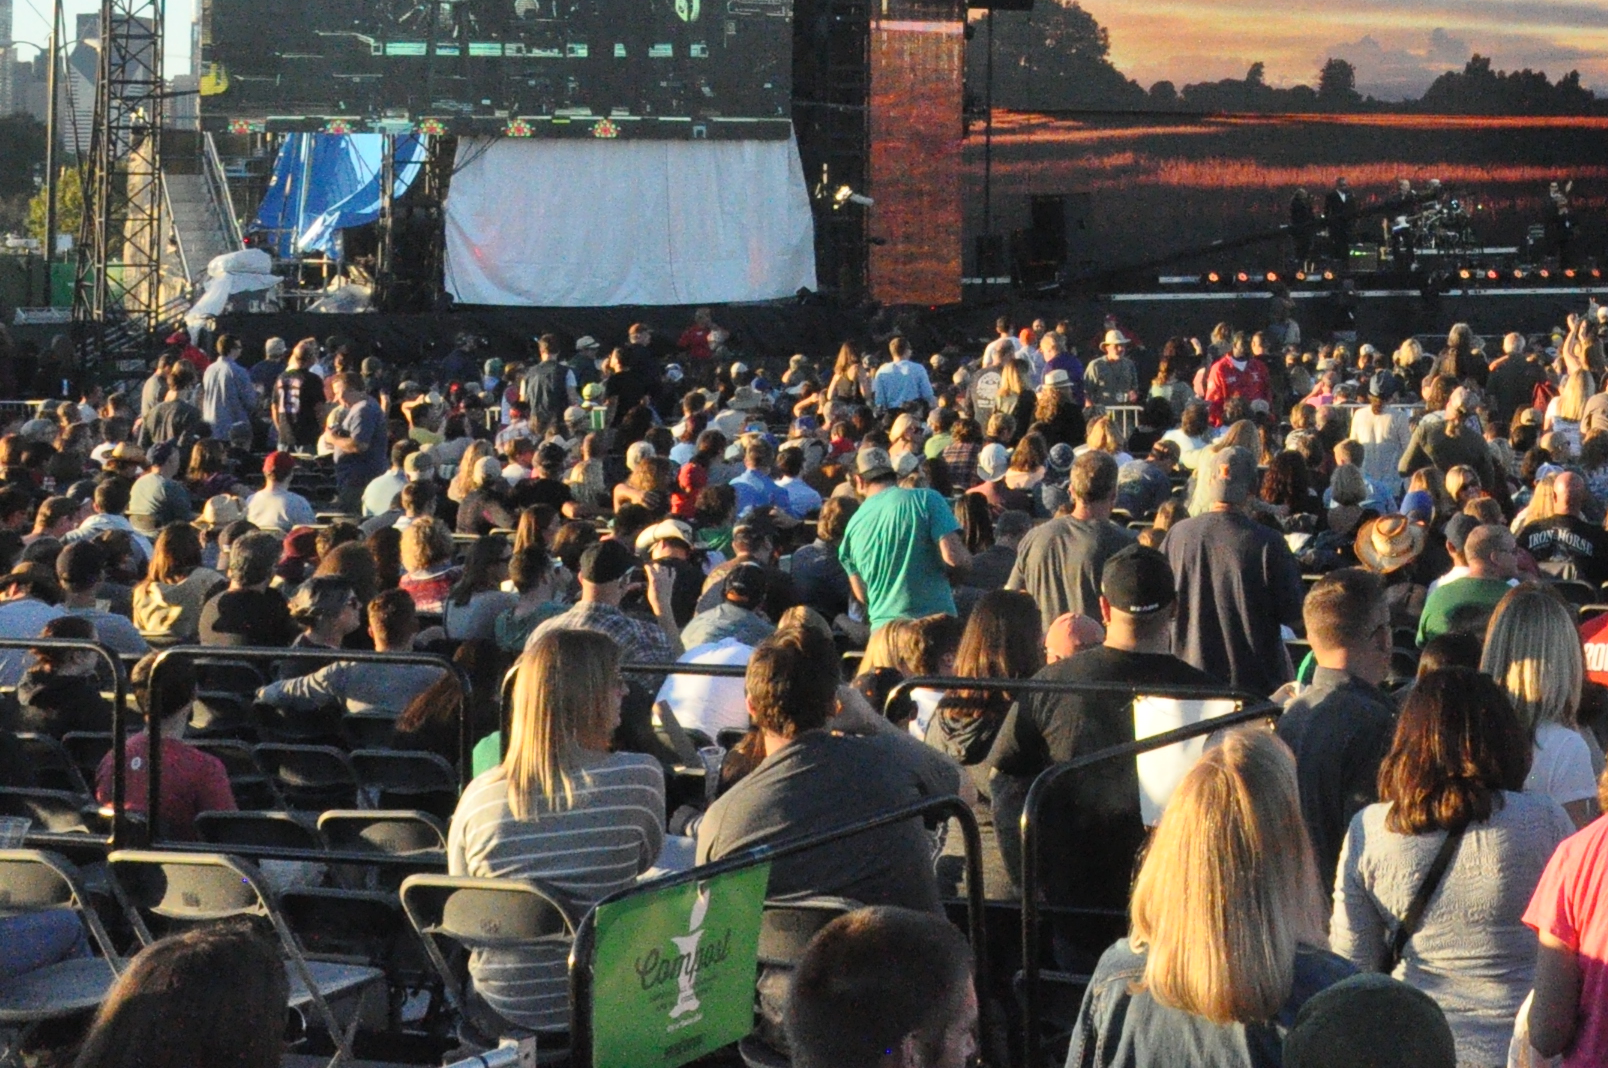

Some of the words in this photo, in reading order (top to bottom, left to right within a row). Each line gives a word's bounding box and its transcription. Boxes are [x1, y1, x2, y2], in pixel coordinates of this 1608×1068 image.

[1527, 529, 1555, 549] IRON
[1557, 528, 1594, 557] HORSE
[634, 928, 731, 990] Compost
